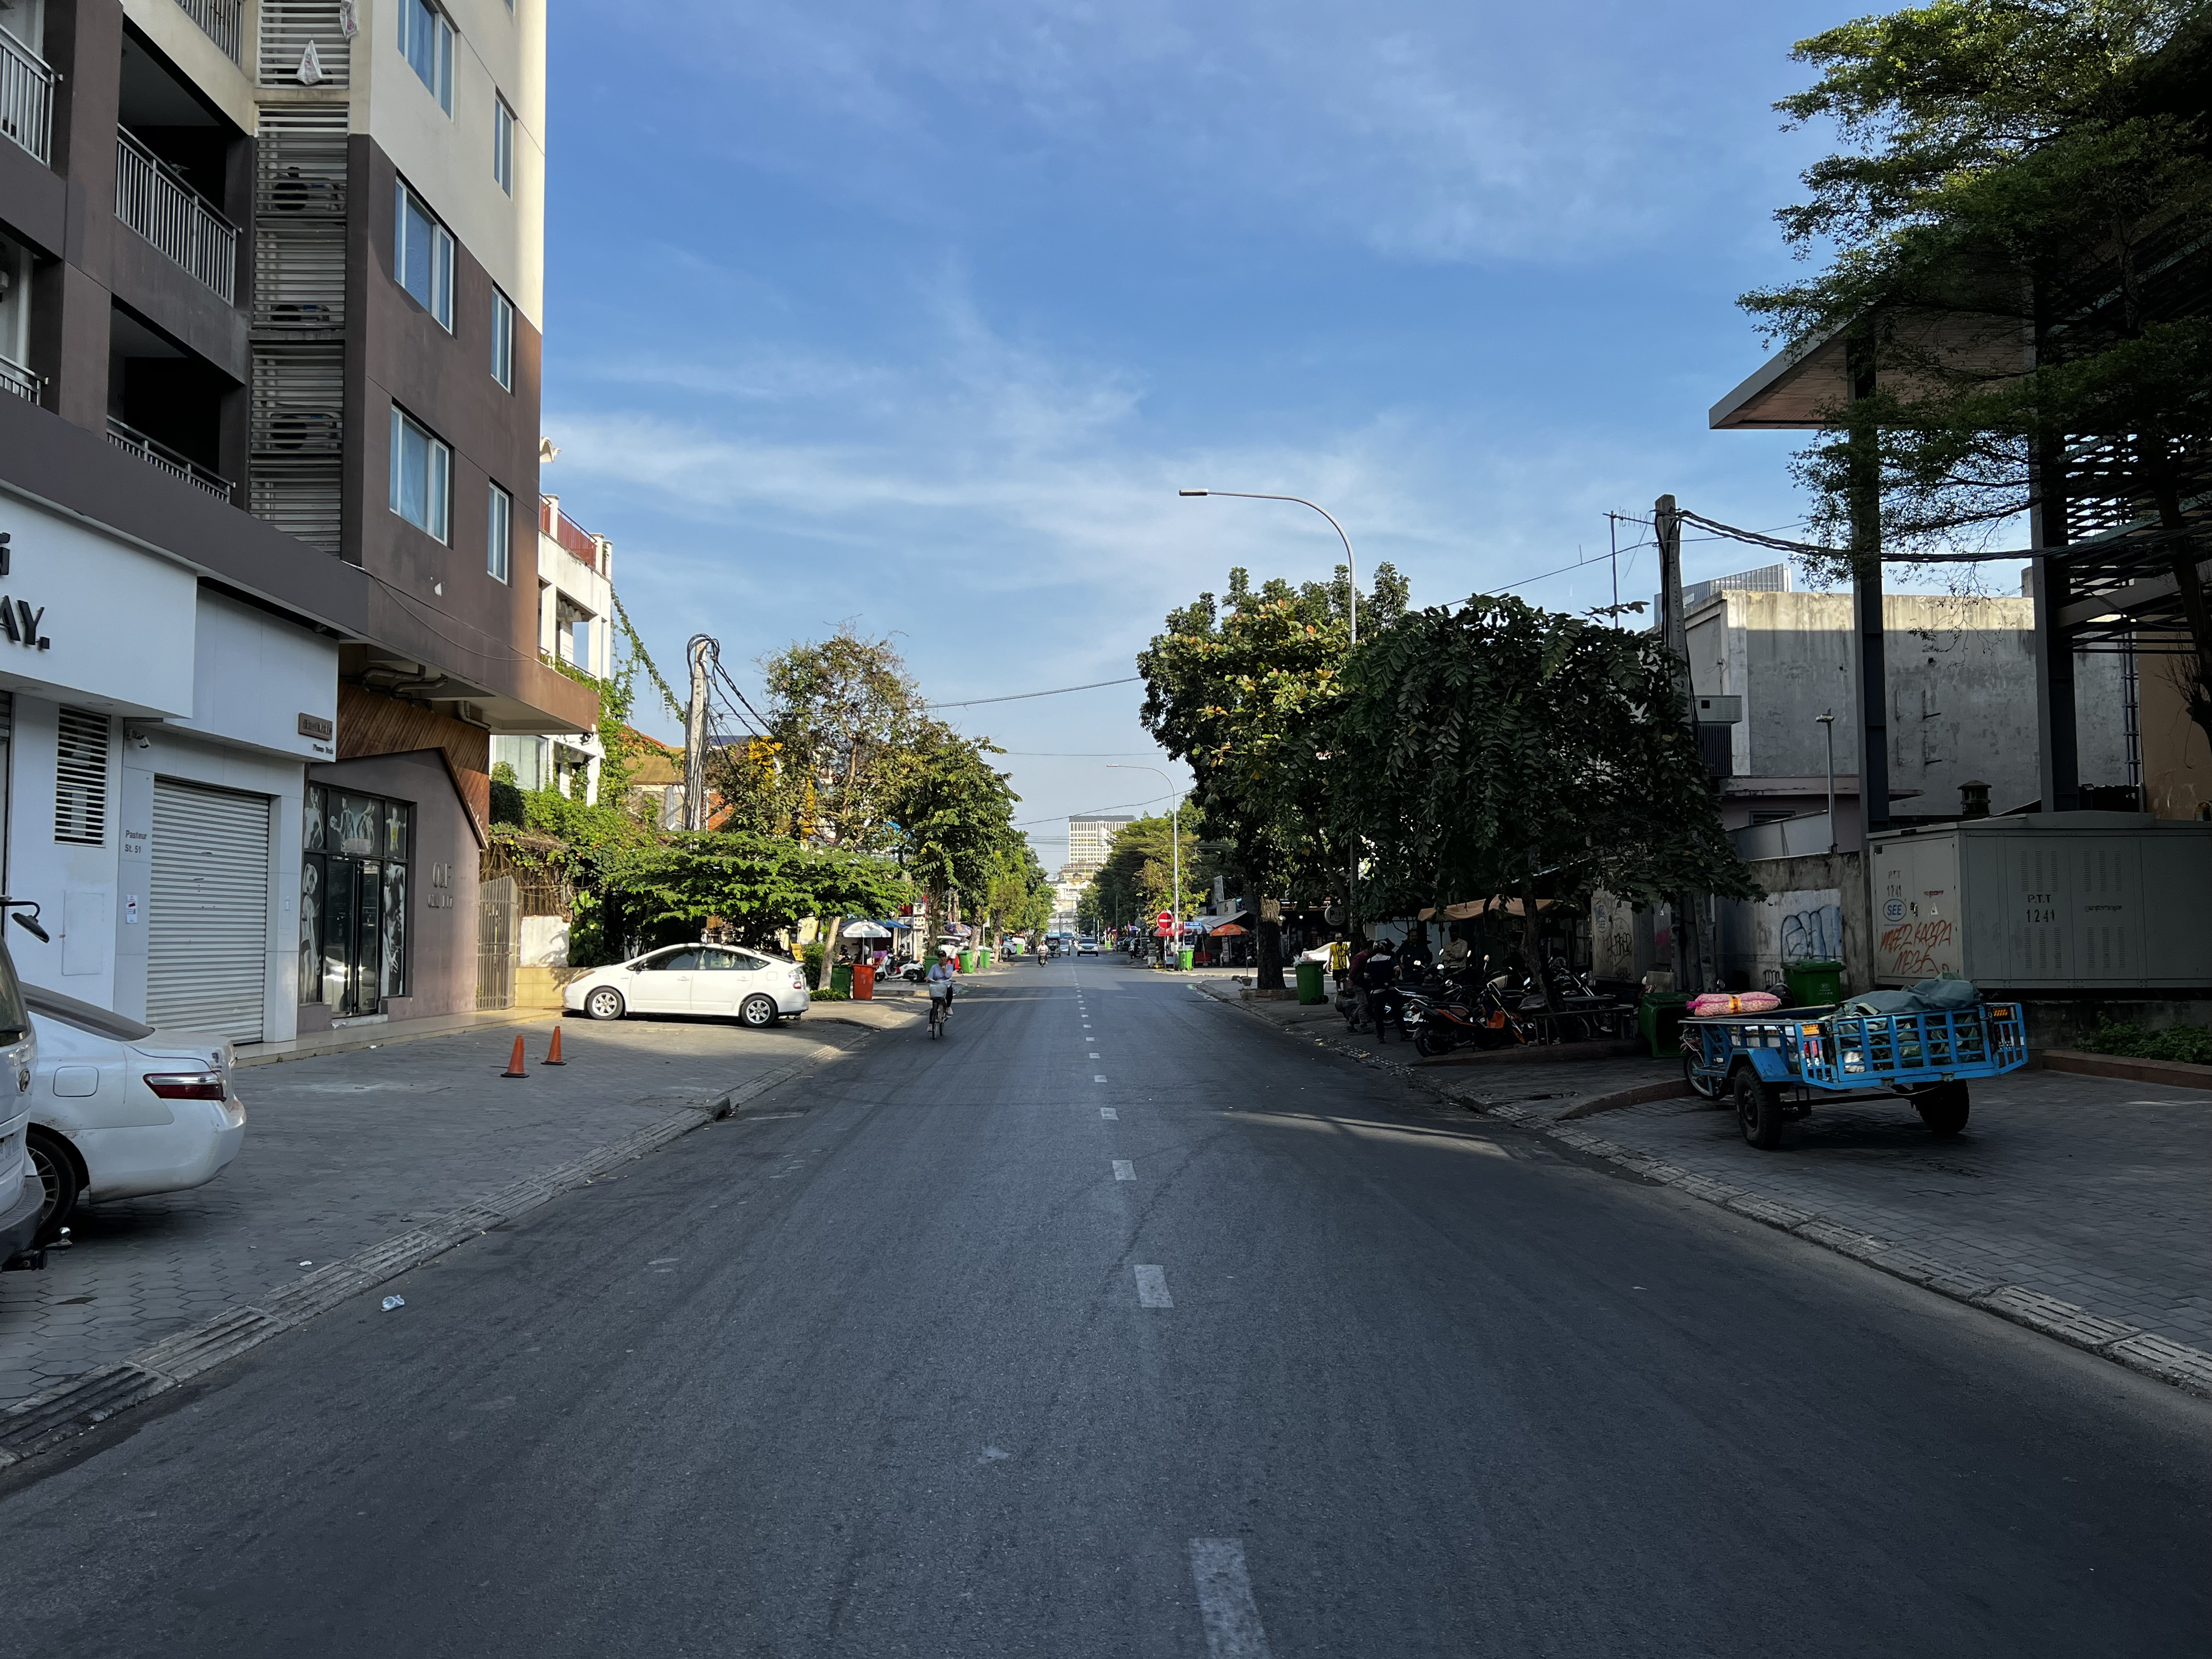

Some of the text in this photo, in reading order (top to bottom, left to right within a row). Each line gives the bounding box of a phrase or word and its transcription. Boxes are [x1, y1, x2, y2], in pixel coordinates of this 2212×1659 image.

[126, 830, 147, 839] Pasteur
[135, 845, 141, 853] 51
[1887, 904, 1902, 916] SEE
[2026, 909, 2056, 922] 1241
